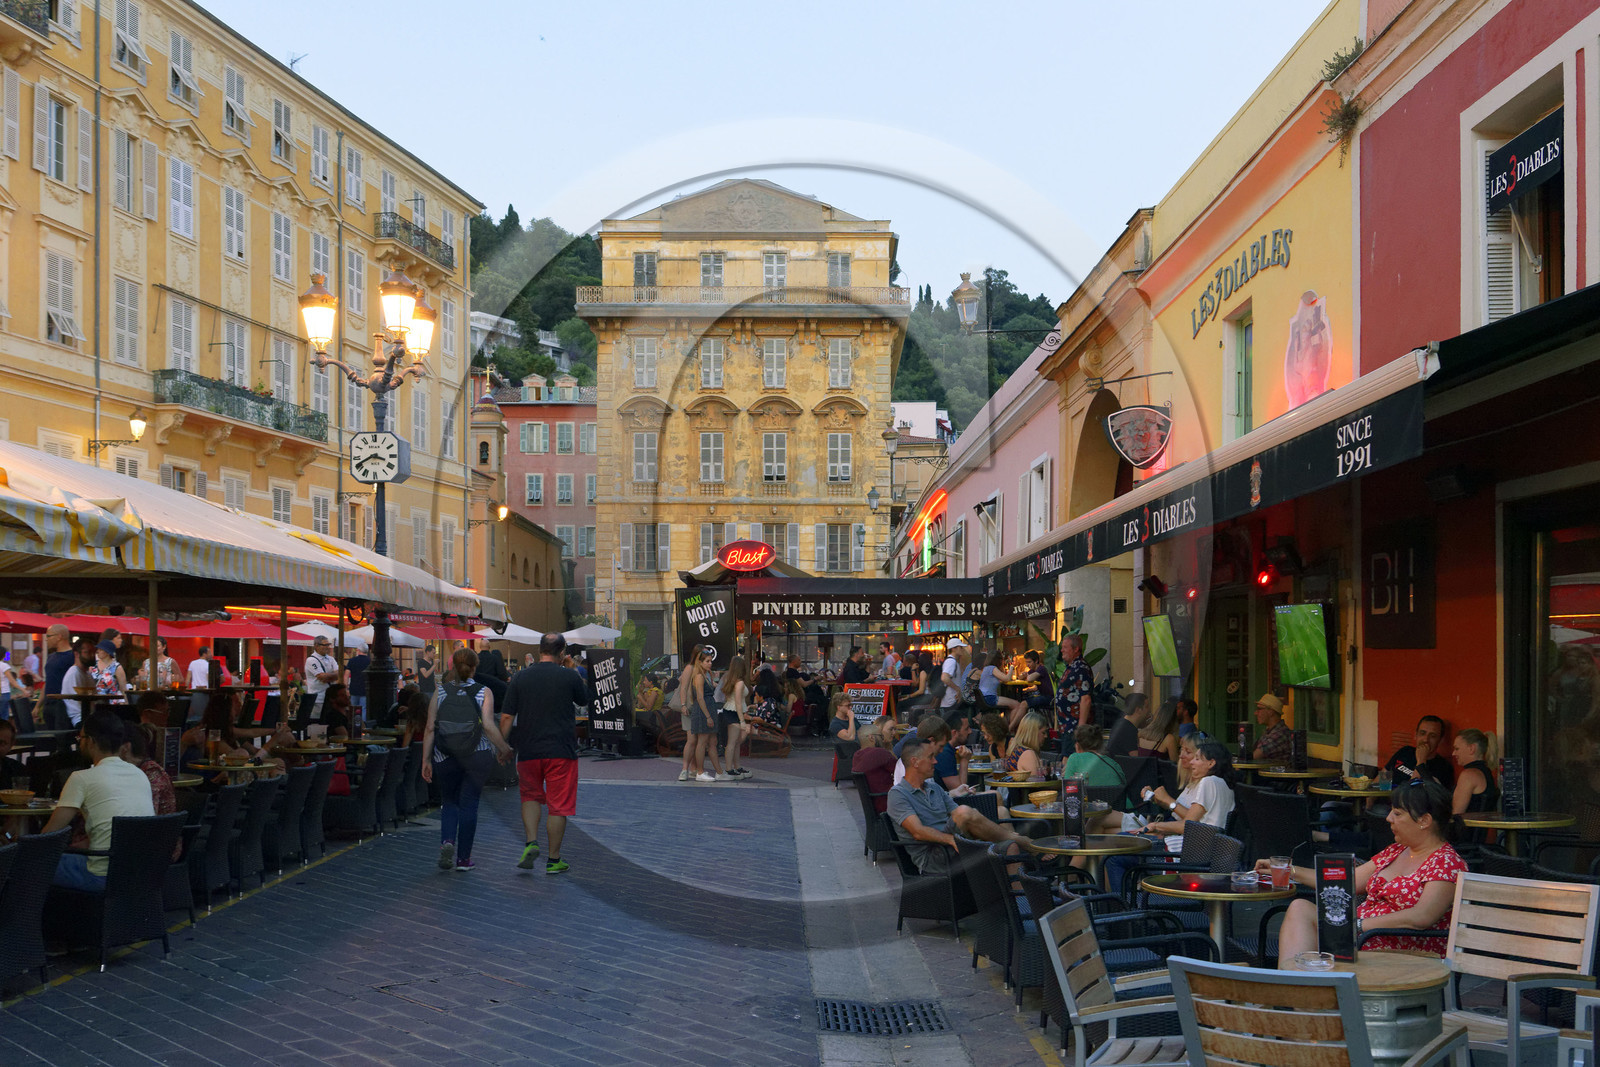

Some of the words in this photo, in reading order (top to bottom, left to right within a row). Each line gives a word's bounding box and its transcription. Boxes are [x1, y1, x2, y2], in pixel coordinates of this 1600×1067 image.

[1490, 172, 1508, 198] LES
[1506, 154, 1517, 196] 3
[1517, 138, 1560, 181] DIABLES
[1191, 281, 1214, 340] LES
[1211, 267, 1224, 322] 3
[1222, 227, 1294, 301] DIABLES
[1336, 414, 1372, 450] SINCE
[1336, 443, 1373, 478] 1991
[1123, 519, 1140, 546] LES
[1141, 507, 1150, 543] 3
[1152, 496, 1196, 537] DIABLES
[726, 547, 768, 566] Blast
[1035, 554, 1041, 580] 3
[1041, 550, 1063, 576] DIABLES
[684, 594, 702, 608] MAXI
[752, 602, 815, 616] PINTHE
[819, 602, 870, 616] BIERE
[881, 602, 916, 617] 3,90
[920, 602, 931, 616] €
[935, 602, 965, 616] YES
[971, 602, 988, 616] !!!
[390, 613, 424, 623] BRASSERIE
[686, 600, 726, 624] MOJITO
[698, 622, 710, 637] 6
[711, 621, 719, 634] €
[593, 657, 617, 679] BIERE
[595, 675, 619, 696] PINTE
[862, 689, 885, 698] DIABLES
[594, 693, 616, 714] 3,90
[852, 704, 882, 714] ARAOKE
